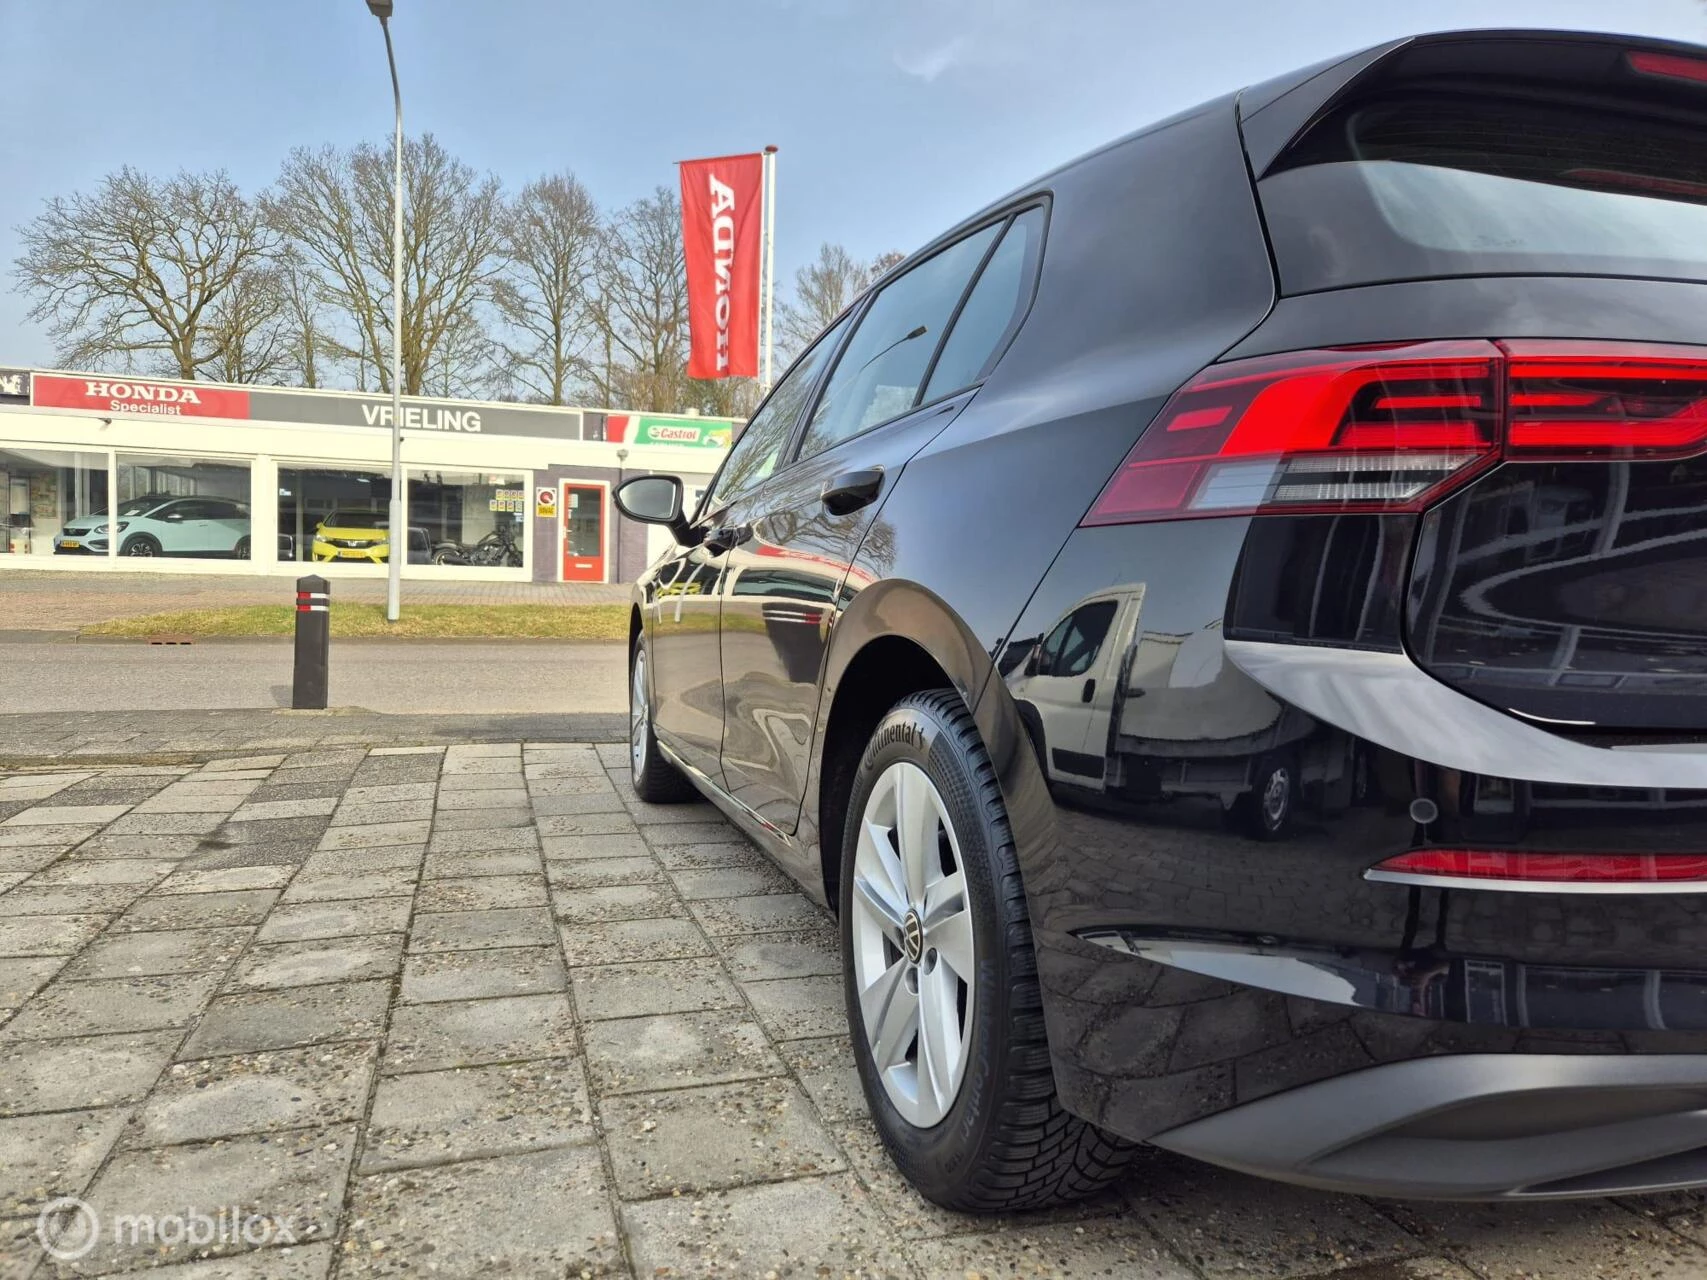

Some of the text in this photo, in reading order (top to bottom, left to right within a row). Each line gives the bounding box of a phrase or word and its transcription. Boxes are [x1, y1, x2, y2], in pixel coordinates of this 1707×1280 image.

[85, 382, 202, 404] HONDA
[110, 399, 181, 415] Specialist
[361, 404, 481, 432] VRIELING
[660, 428, 697, 439] Castrol
